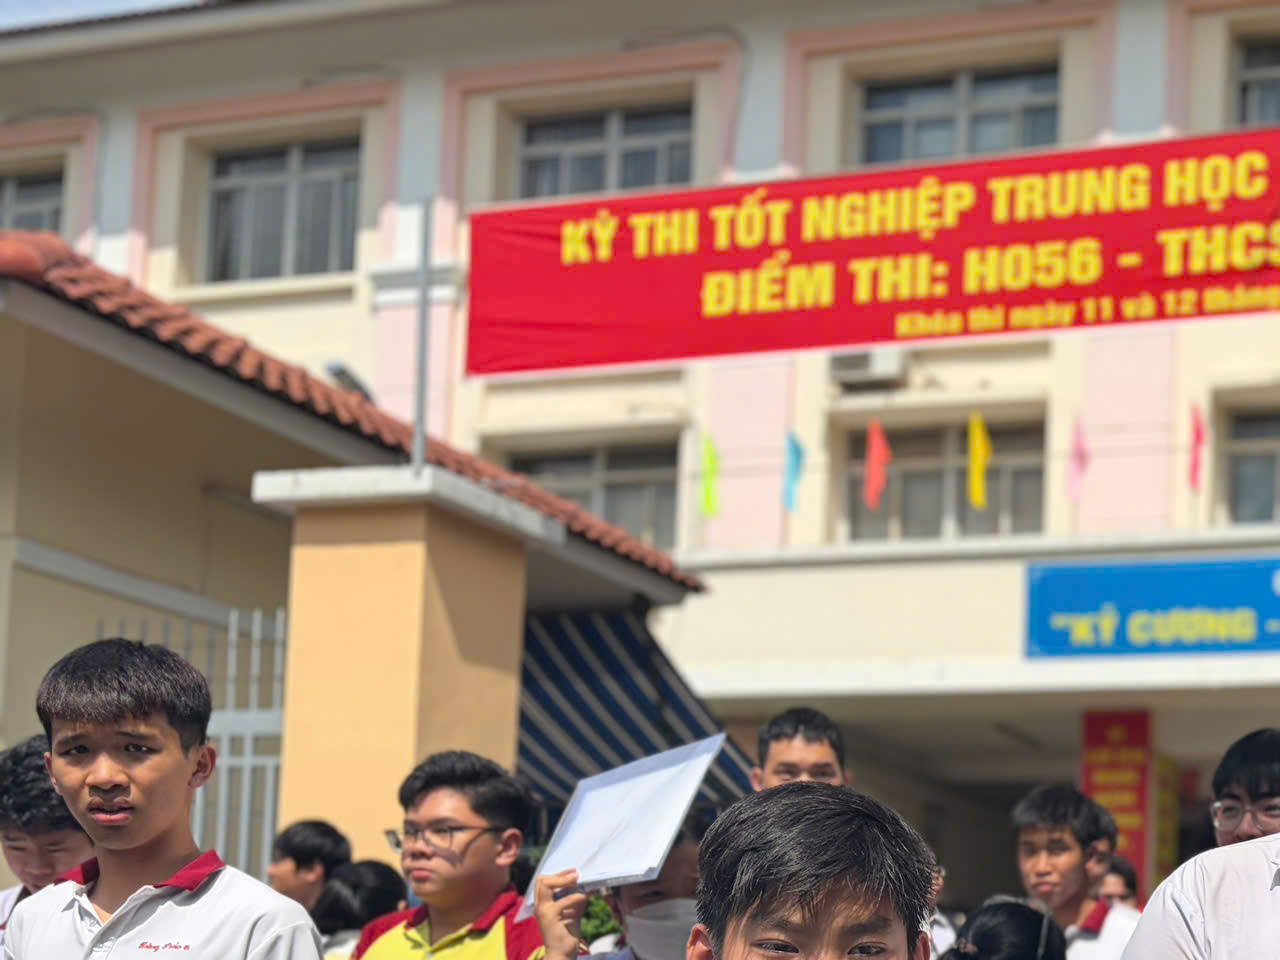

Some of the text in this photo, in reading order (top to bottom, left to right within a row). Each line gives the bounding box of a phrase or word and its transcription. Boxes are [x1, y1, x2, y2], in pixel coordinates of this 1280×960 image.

[630, 210, 699, 258] THI
[709, 188, 792, 251] TỐT
[801, 175, 976, 240] NGHIỆP
[987, 164, 1151, 224] TRUNG
[1163, 151, 1268, 212] HỌC
[701, 249, 835, 318] ĐIỂM
[848, 253, 949, 304] THI:
[967, 303, 1005, 333] thi
[1008, 299, 1076, 330] ngày
[1083, 296, 1114, 322] 11
[1121, 291, 1157, 319] và
[1163, 286, 1199, 317] 12
